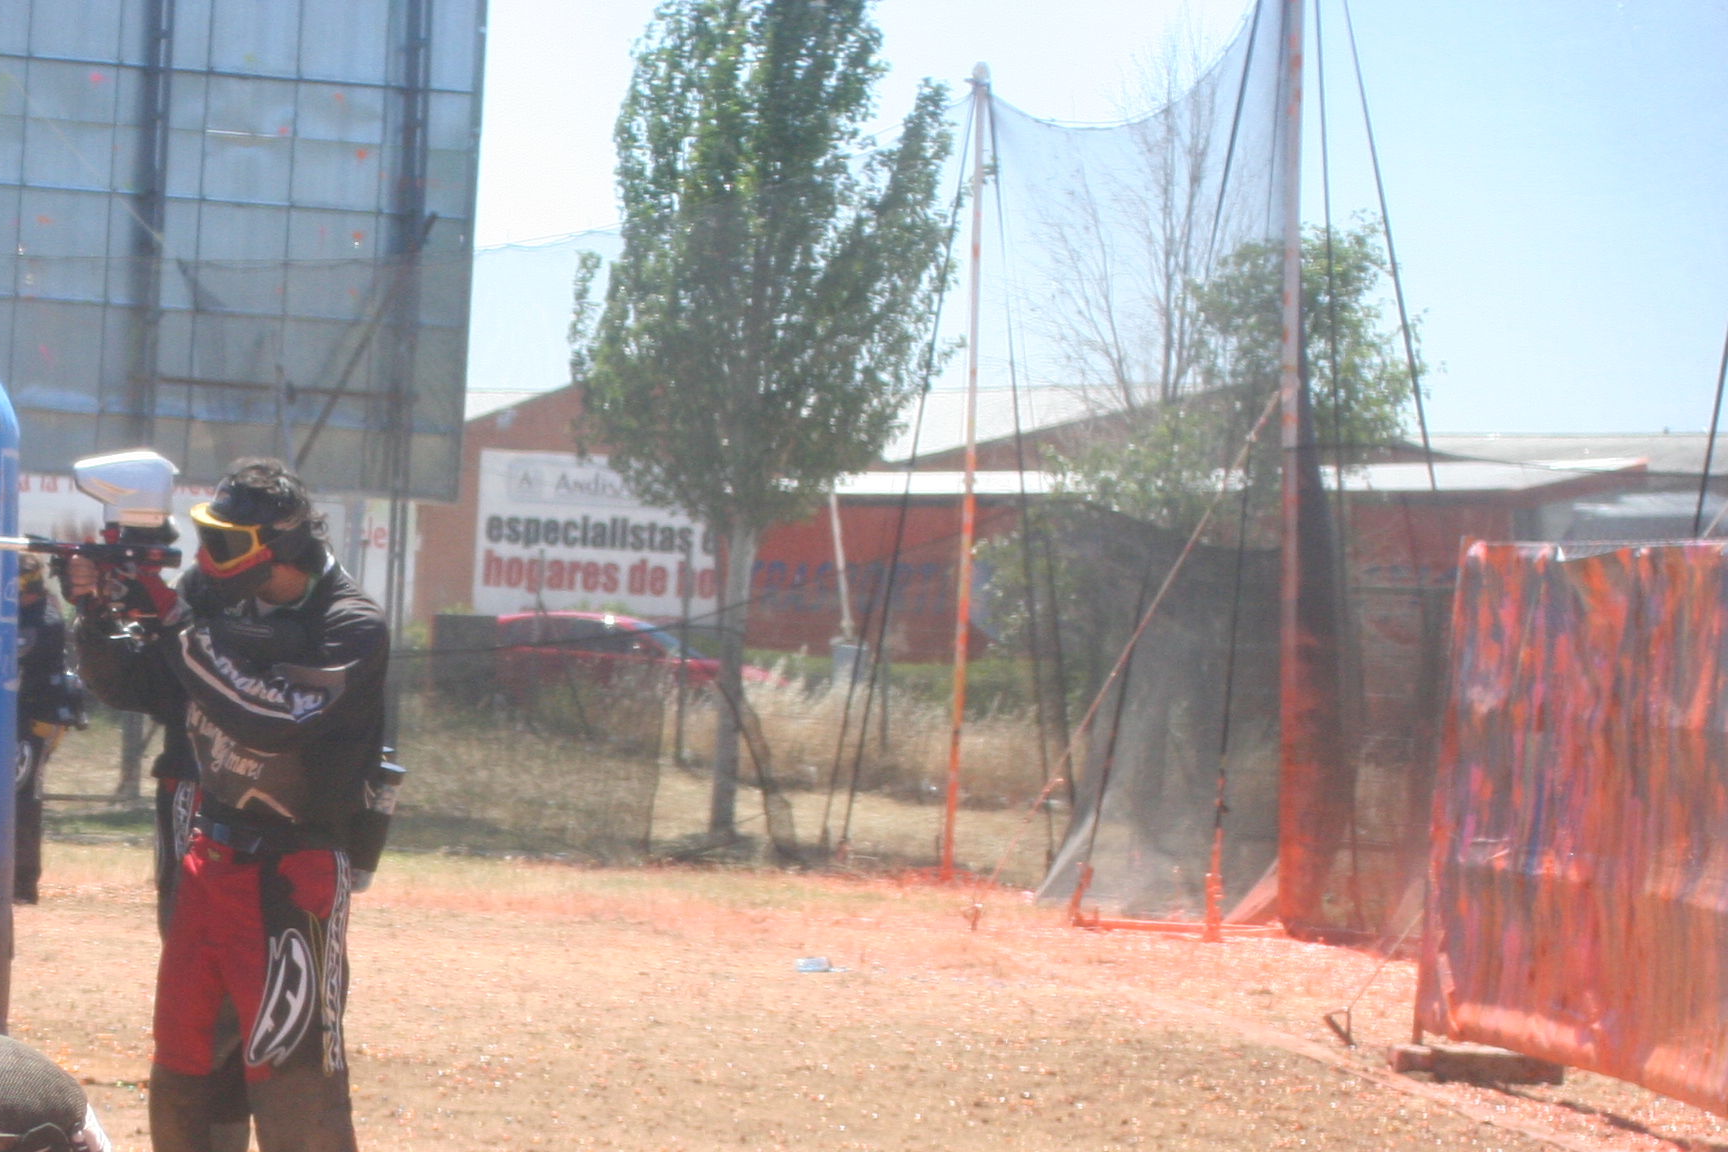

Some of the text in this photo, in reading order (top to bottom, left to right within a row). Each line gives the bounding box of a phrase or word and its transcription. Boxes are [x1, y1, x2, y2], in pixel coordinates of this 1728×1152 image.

[485, 514, 693, 554] especialistas
[483, 548, 620, 595] hogares
[628, 558, 667, 597] de
